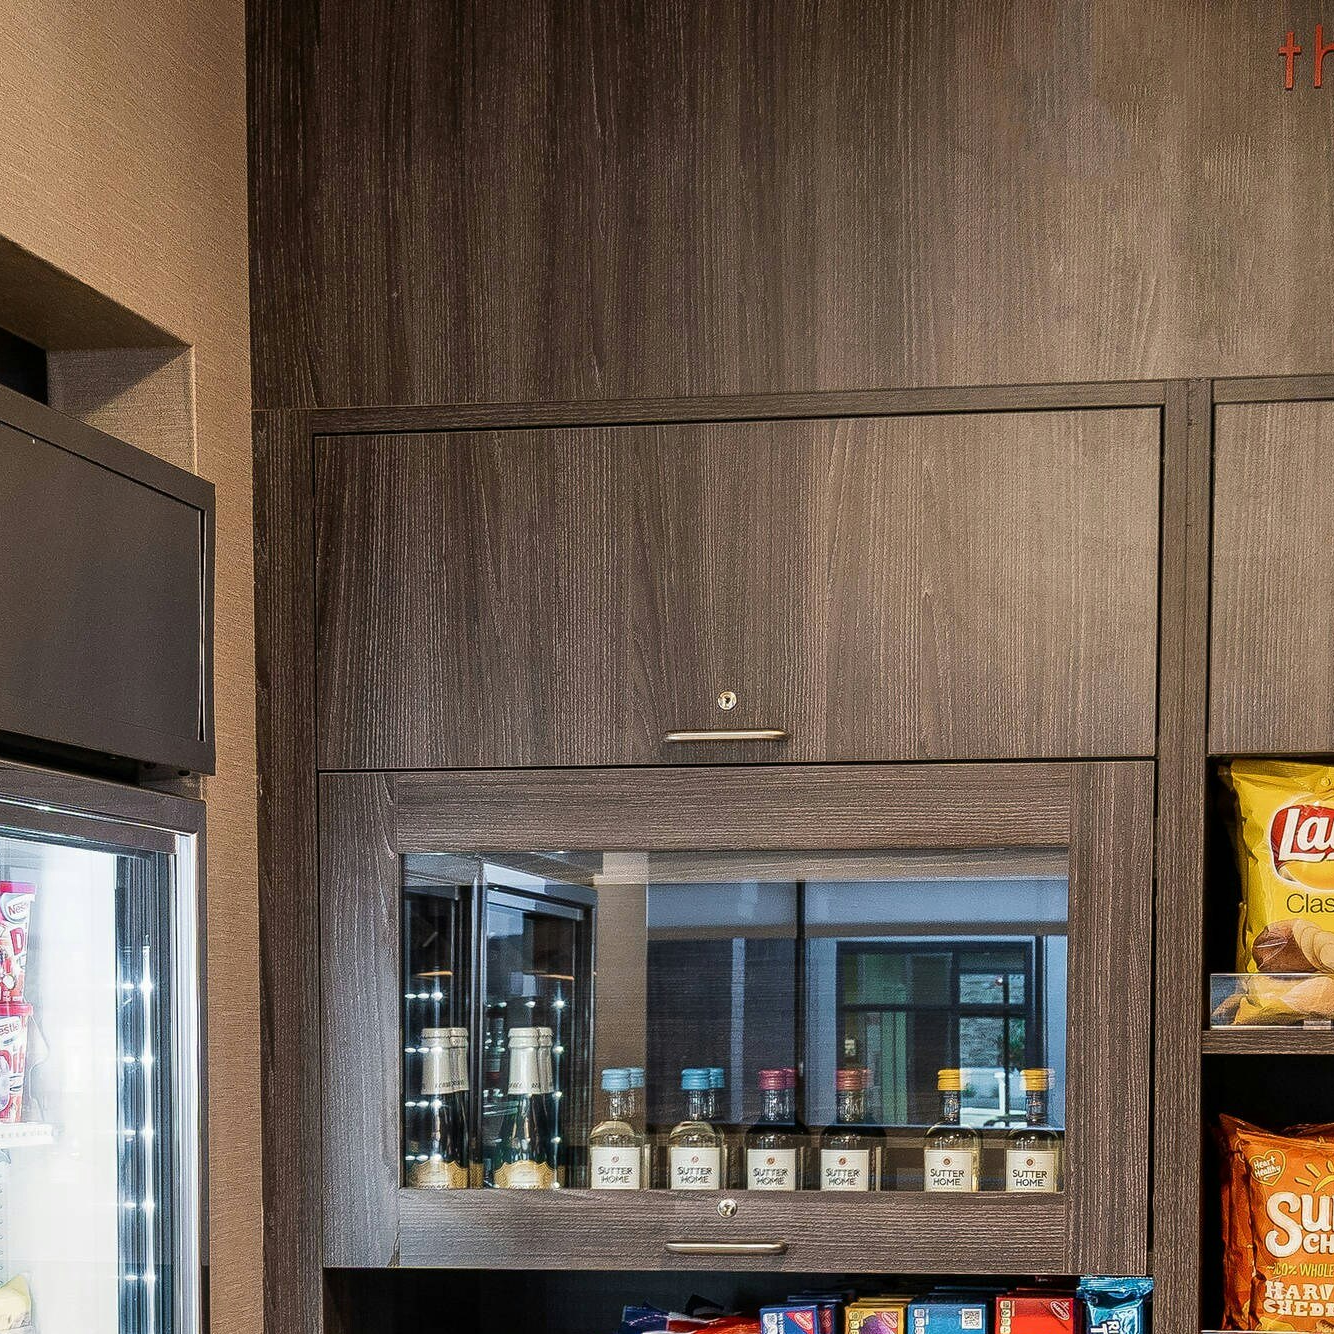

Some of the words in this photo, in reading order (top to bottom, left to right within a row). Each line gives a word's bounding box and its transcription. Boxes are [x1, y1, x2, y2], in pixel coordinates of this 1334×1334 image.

[598, 1167, 633, 1176] SUTTER
[677, 1167, 713, 1176] SUTTER
[753, 1168, 788, 1177] SUTTER
[825, 1168, 859, 1177] SUTTER
[930, 1169, 964, 1178] SUTTER
[1012, 1169, 1047, 1179] SUTTER
[602, 1176, 630, 1184] HOME
[681, 1176, 709, 1184] HOME
[756, 1177, 785, 1186] HOME
[829, 1177, 856, 1185] HOME
[934, 1178, 961, 1186] HOME
[1016, 1178, 1043, 1187] HOME
[1300, 1264, 1334, 1277] WHOLE
